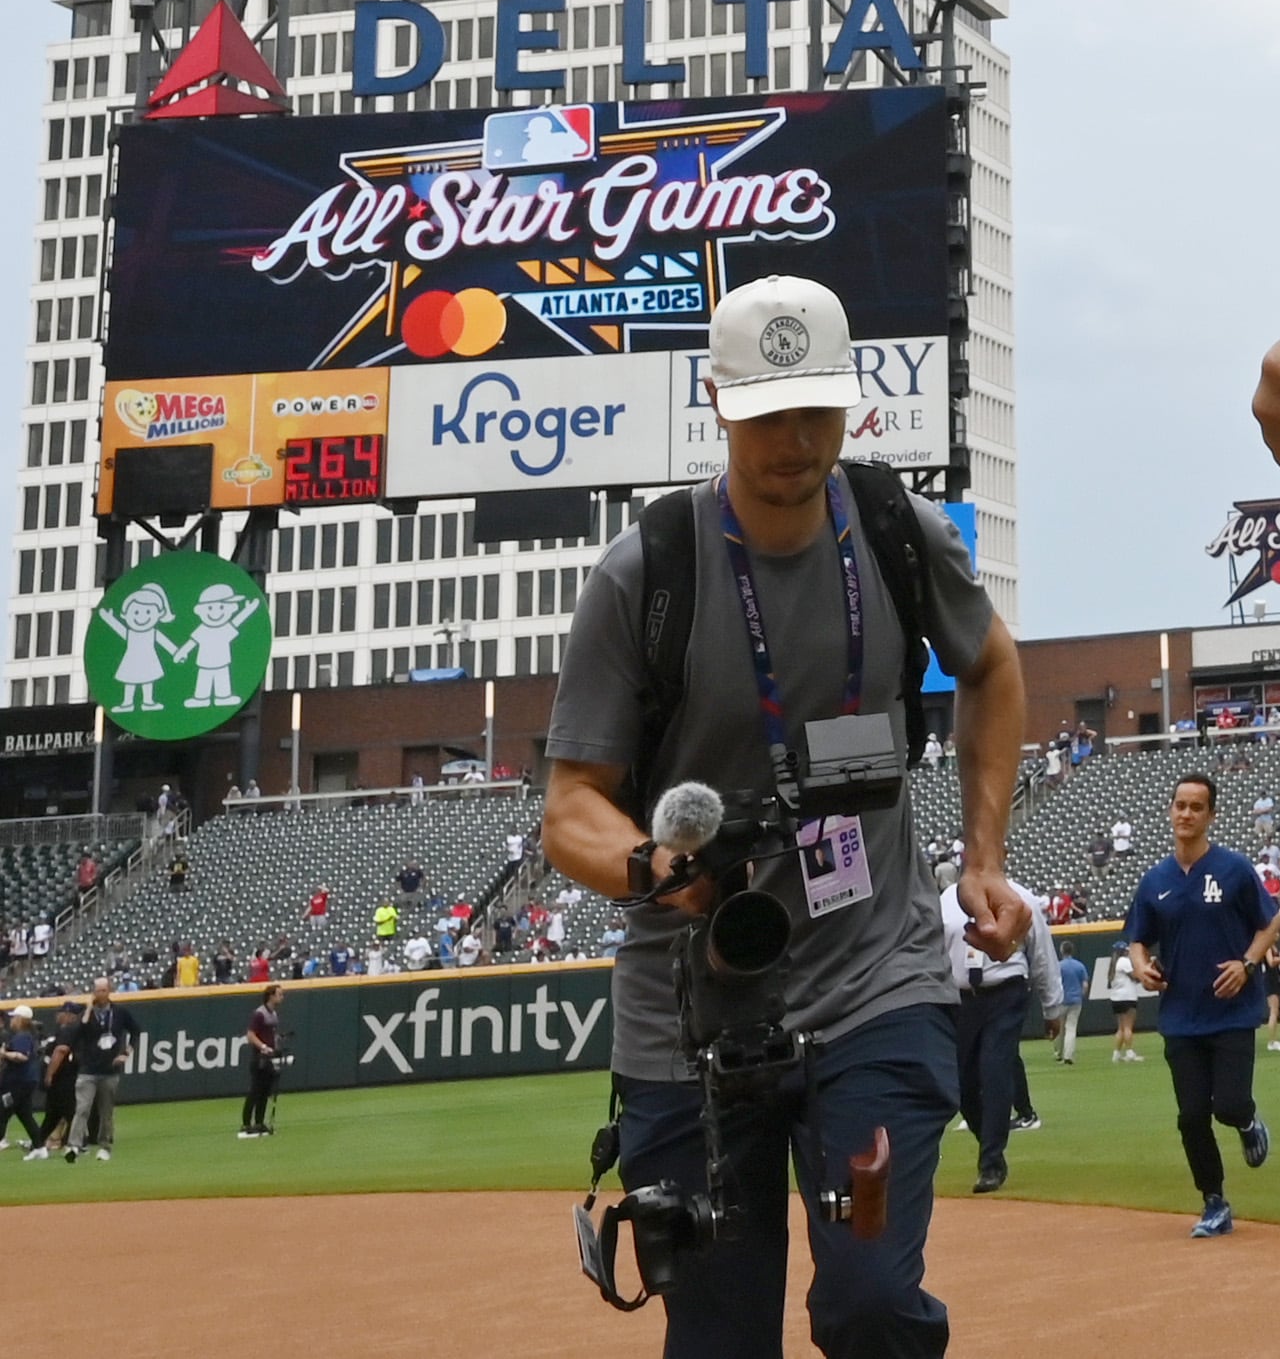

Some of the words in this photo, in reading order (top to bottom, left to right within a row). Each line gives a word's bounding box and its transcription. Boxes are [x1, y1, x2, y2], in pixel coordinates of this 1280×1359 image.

[251, 184, 402, 273] All
[403, 171, 577, 261] Star
[576, 153, 828, 261] Game
[540, 291, 629, 316] ATLANTA
[642, 287, 701, 311] 2025
[778, 333, 791, 351] LA
[153, 393, 225, 423] MEGA
[146, 416, 225, 440] MILLIONS
[431, 371, 626, 477] Kroger
[285, 435, 382, 481] 264
[871, 449, 934, 465] Provider
[285, 478, 379, 502] MILLION
[1205, 514, 1267, 555] All
[4, 731, 84, 753] BALLPARK
[1203, 874, 1223, 903] LA
[359, 984, 607, 1074] xfinity
